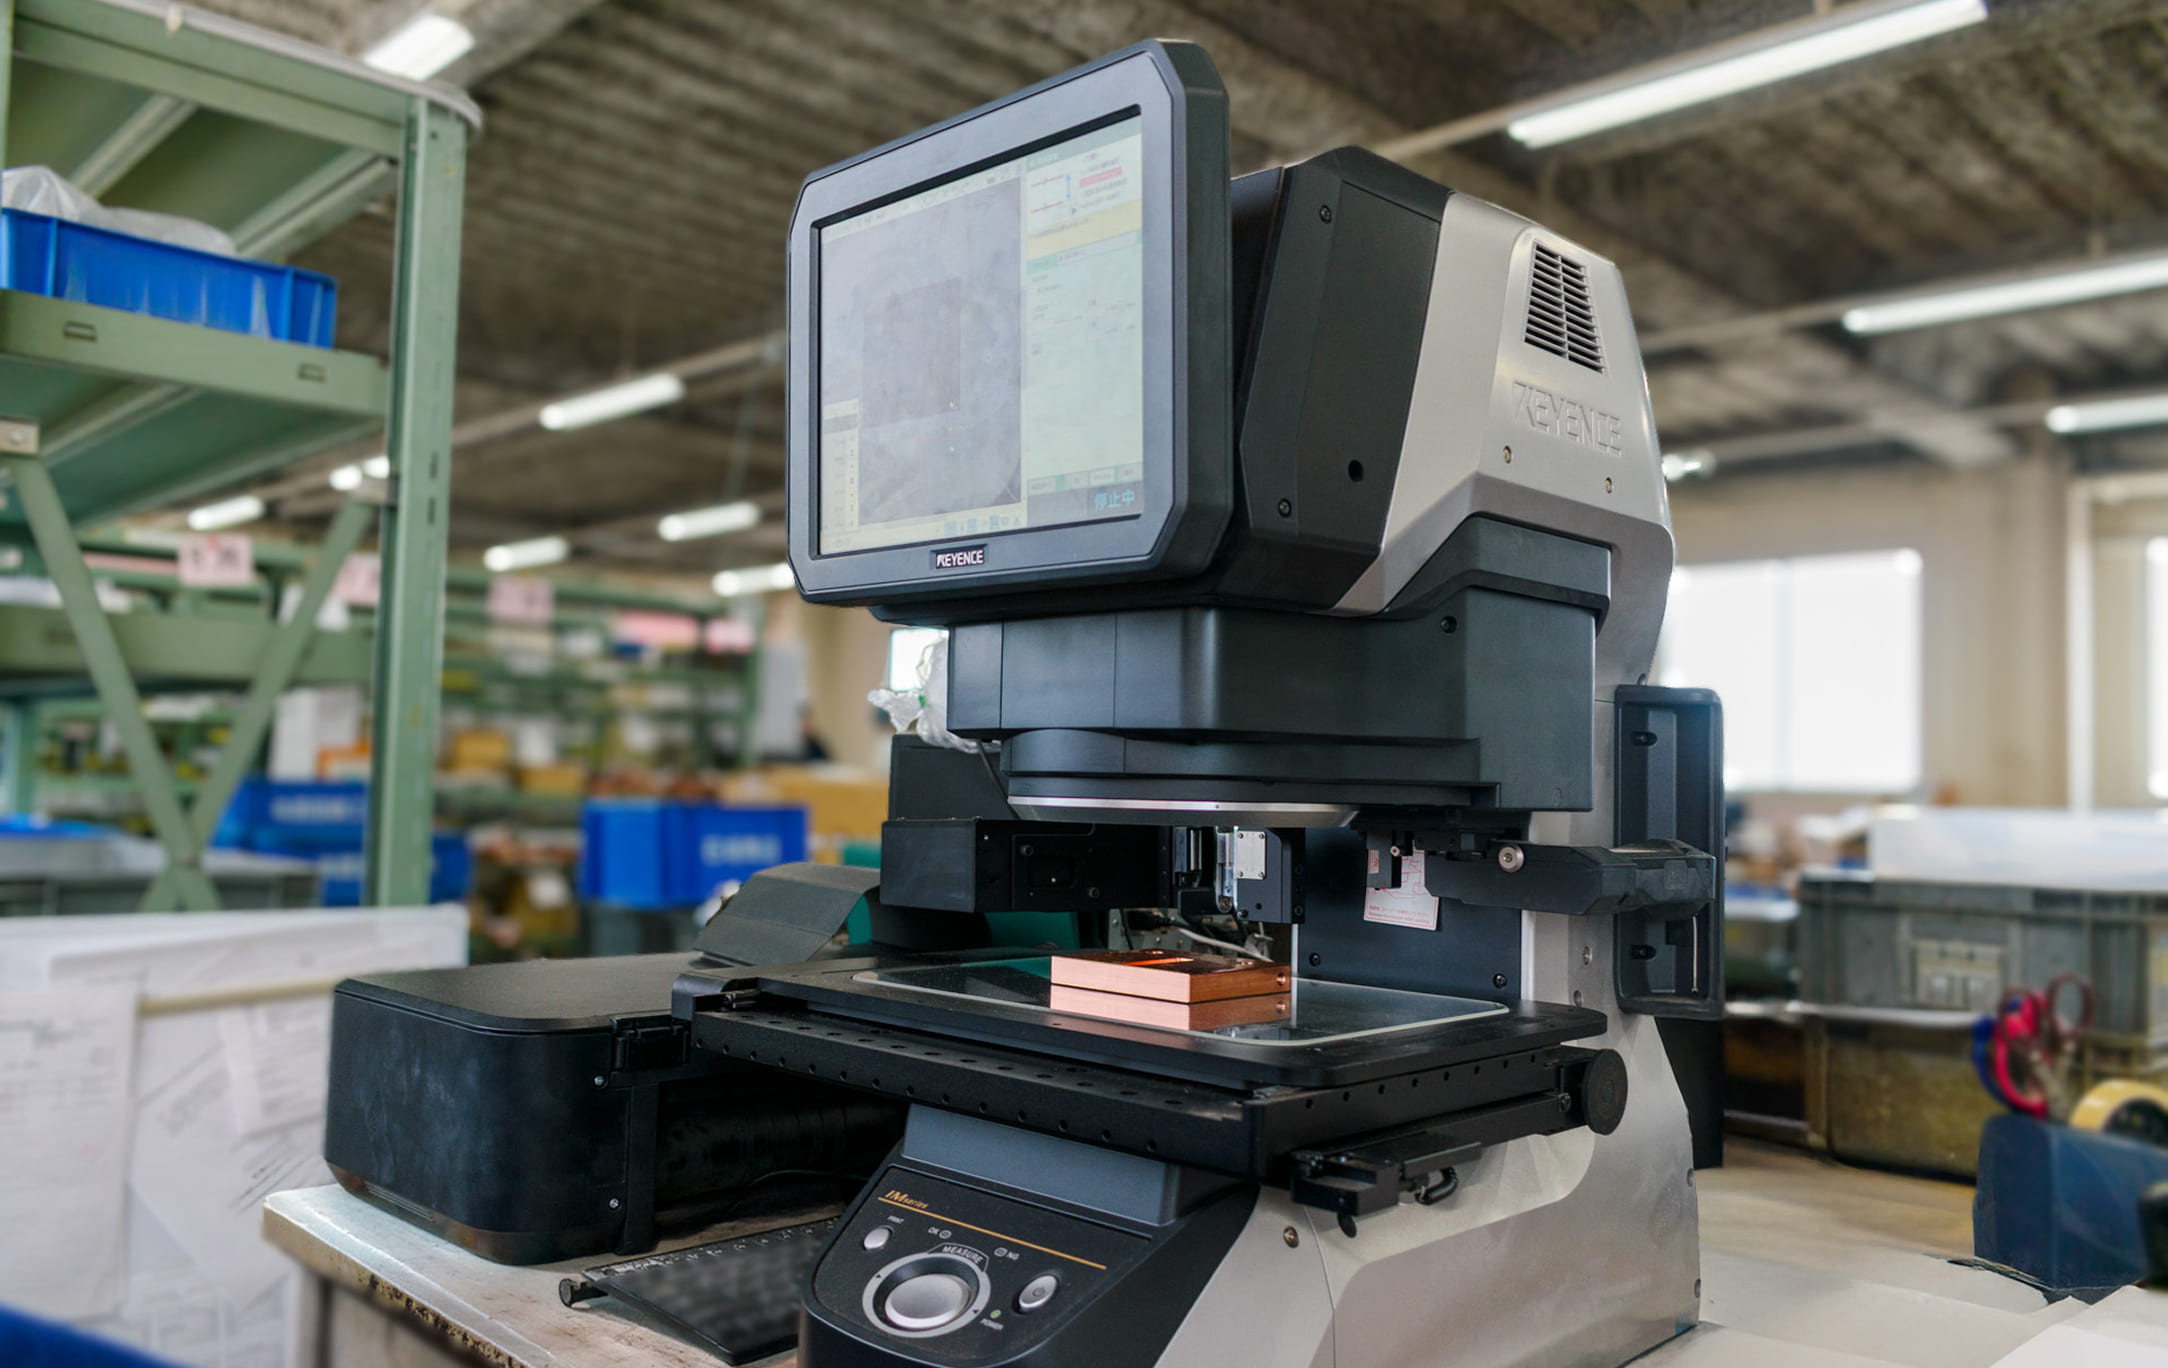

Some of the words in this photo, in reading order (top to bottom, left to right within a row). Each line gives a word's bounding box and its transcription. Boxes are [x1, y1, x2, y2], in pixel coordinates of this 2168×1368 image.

[1513, 380, 1622, 457] KEYENCE
[936, 550, 984, 568] KEYENCE
[942, 1246, 983, 1264] MEASURE
